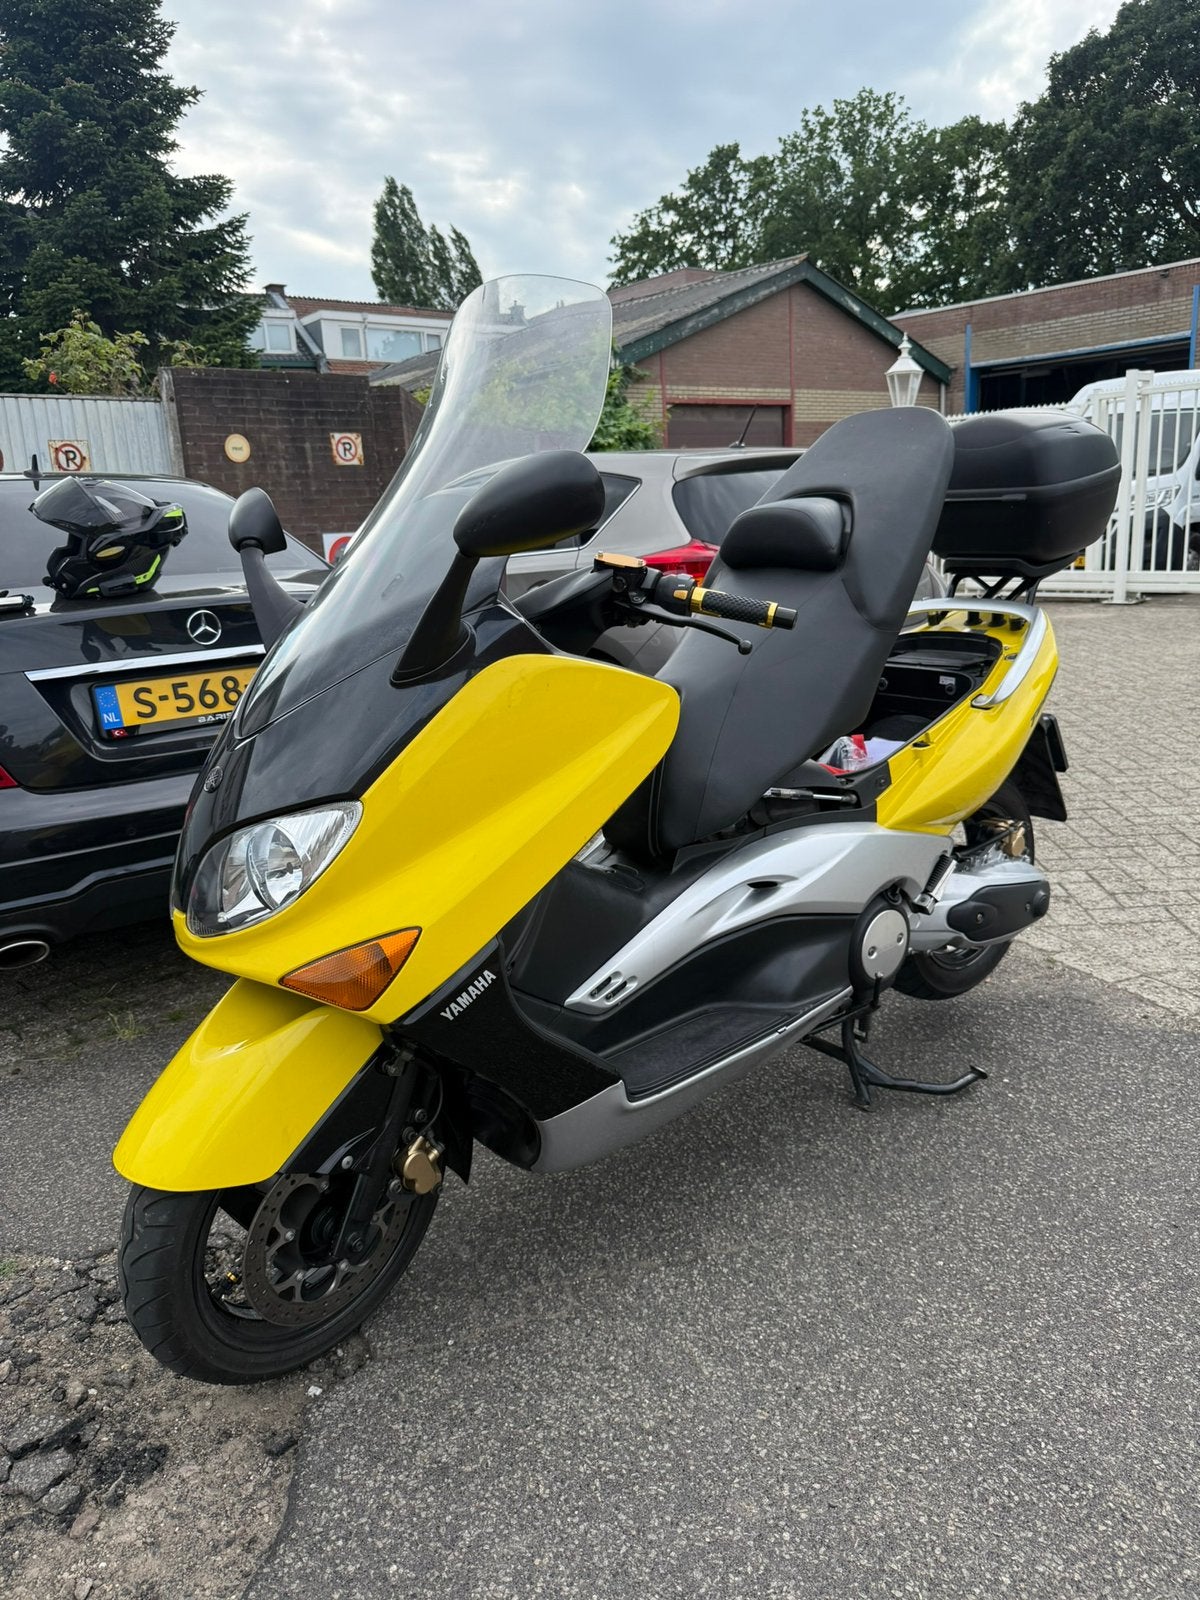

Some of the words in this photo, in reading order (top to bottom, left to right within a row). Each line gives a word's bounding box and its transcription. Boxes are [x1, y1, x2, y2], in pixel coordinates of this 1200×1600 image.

[342, 441, 352, 457] P
[64, 449, 77, 468] P
[103, 712, 120, 724] NL
[440, 970, 497, 1021] YAMAHA
